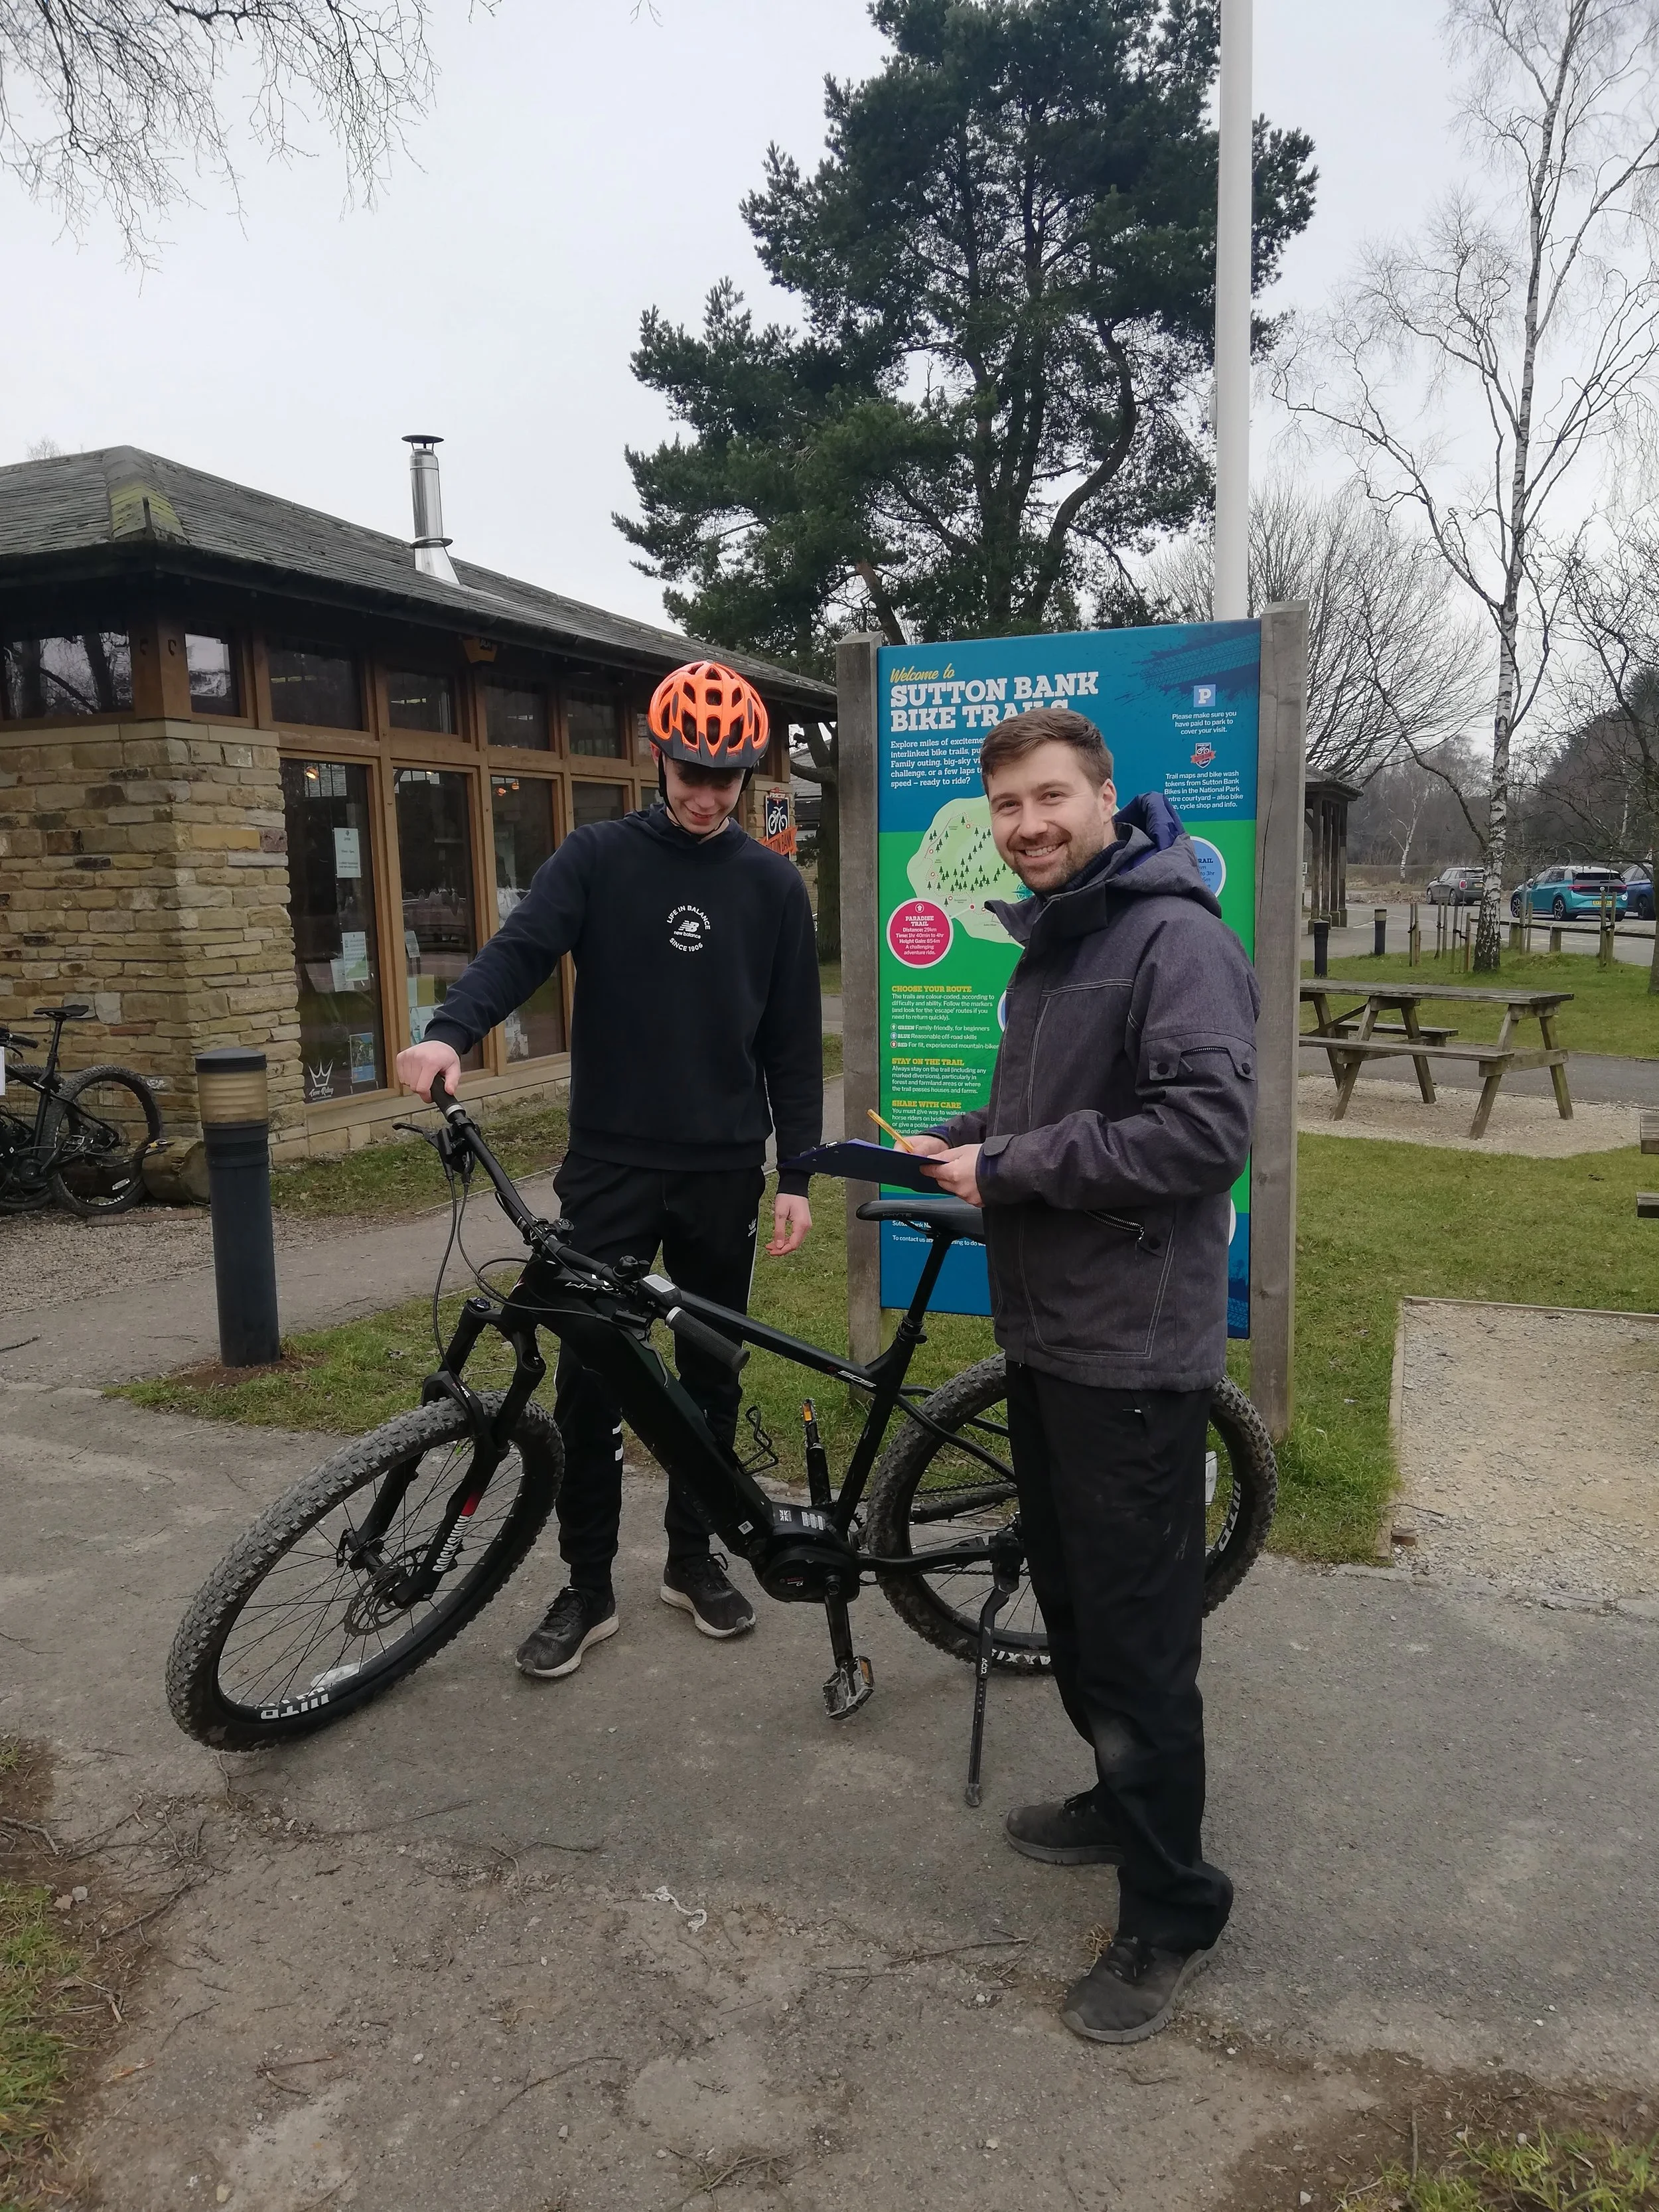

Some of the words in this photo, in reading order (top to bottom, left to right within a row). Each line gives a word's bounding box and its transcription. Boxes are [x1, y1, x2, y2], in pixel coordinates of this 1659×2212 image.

[891, 666, 939, 682] Welcome
[943, 663, 955, 678] to
[891, 680, 1006, 707] SUTTON
[1014, 672, 1098, 700] BANK
[1198, 688, 1211, 703] P
[891, 706, 956, 732] BIKE
[962, 700, 1068, 727] TRAI
[1212, 718, 1225, 727] park
[891, 741, 918, 750] Explore
[891, 749, 929, 758] interlinked
[891, 759, 915, 768] Family
[944, 757, 971, 766] big-sky
[960, 767, 975, 775] laps
[891, 779, 911, 788] speed
[920, 778, 940, 786] ready
[667, 909, 678, 923] LIFE
[687, 905, 710, 930] BALANCE
[670, 938, 687, 951] SINCE
[688, 942, 703, 952] 1906
[433, 1515, 472, 1572] ROCKSHOX
